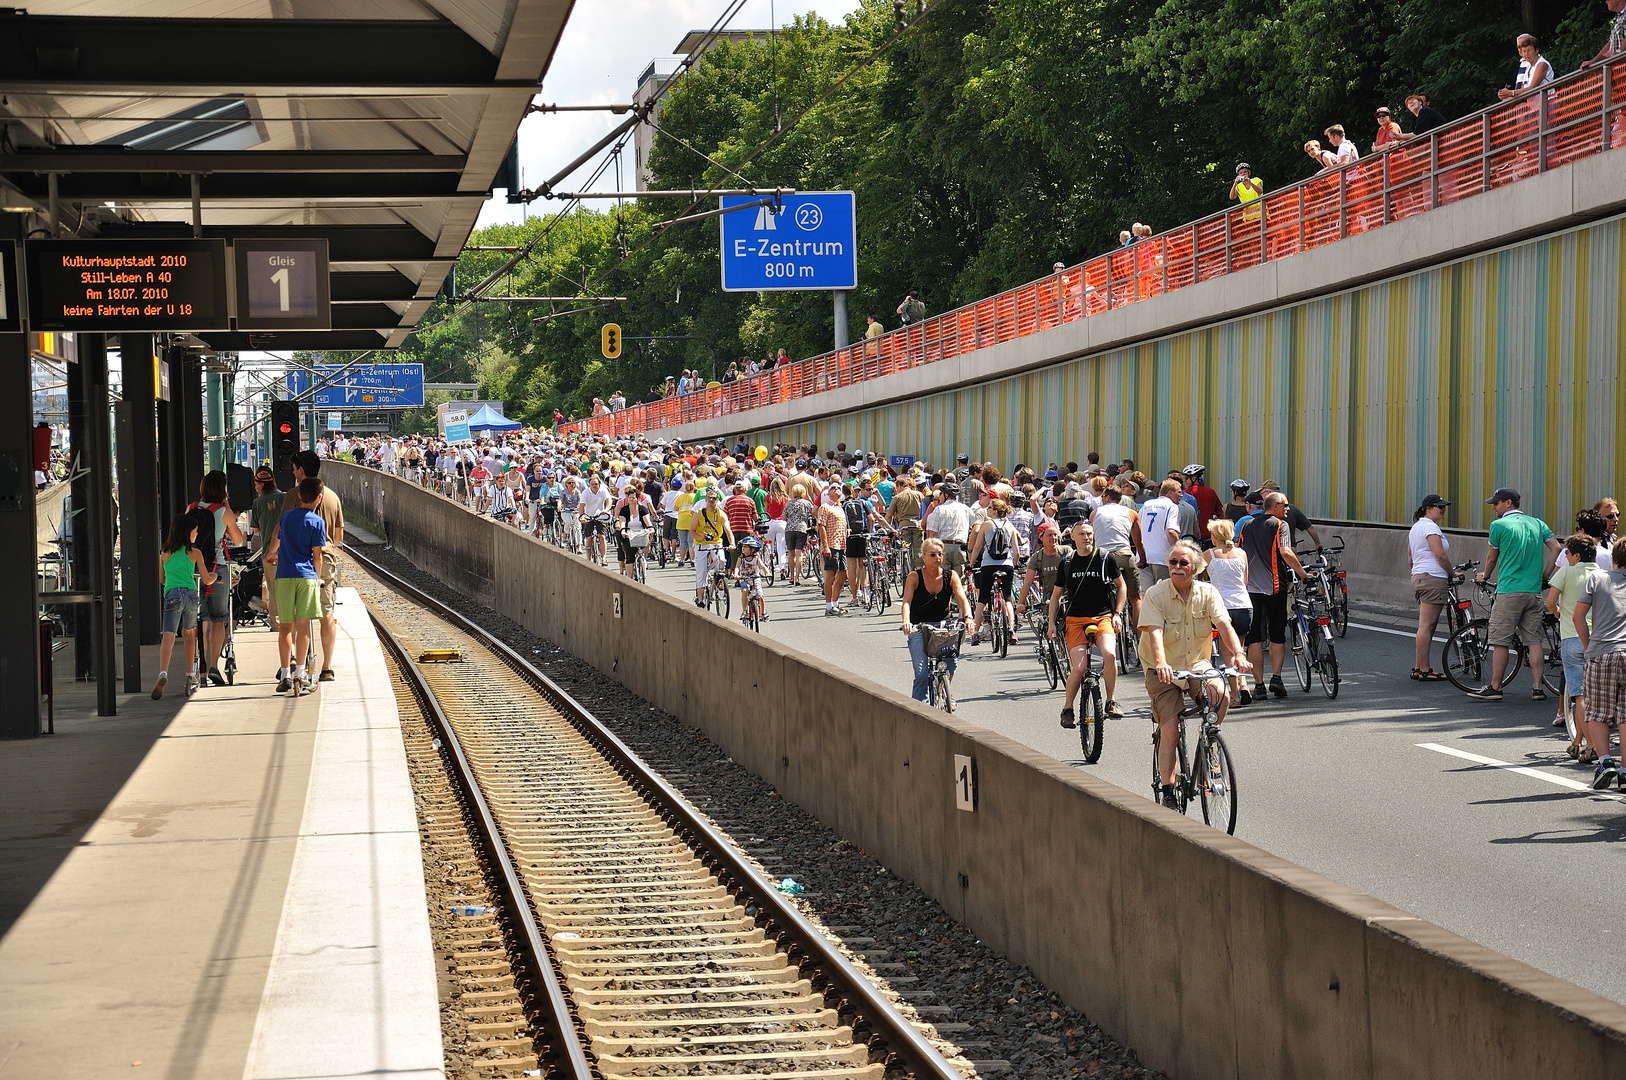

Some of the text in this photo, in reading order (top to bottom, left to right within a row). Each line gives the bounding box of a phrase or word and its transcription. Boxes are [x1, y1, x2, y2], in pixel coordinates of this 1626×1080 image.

[800, 209, 819, 225] 23
[734, 238, 843, 257] E-Zentrum
[62, 255, 187, 270] Kulturhauptstadt 2010
[268, 255, 296, 266] Gleis
[81, 271, 172, 284] Still-Leben A 40
[765, 262, 814, 278] 800 m
[86, 288, 169, 300] Am 18.07. 2010
[270, 268, 290, 312] 1
[63, 303, 193, 316] keine Fahrten der U 18
[360, 367, 420, 376] E-Zentrum (Ost)
[41, 461, 49, 470] 3
[1147, 512, 1158, 533] 7
[615, 597, 619, 614] 2
[960, 765, 969, 802] 1
